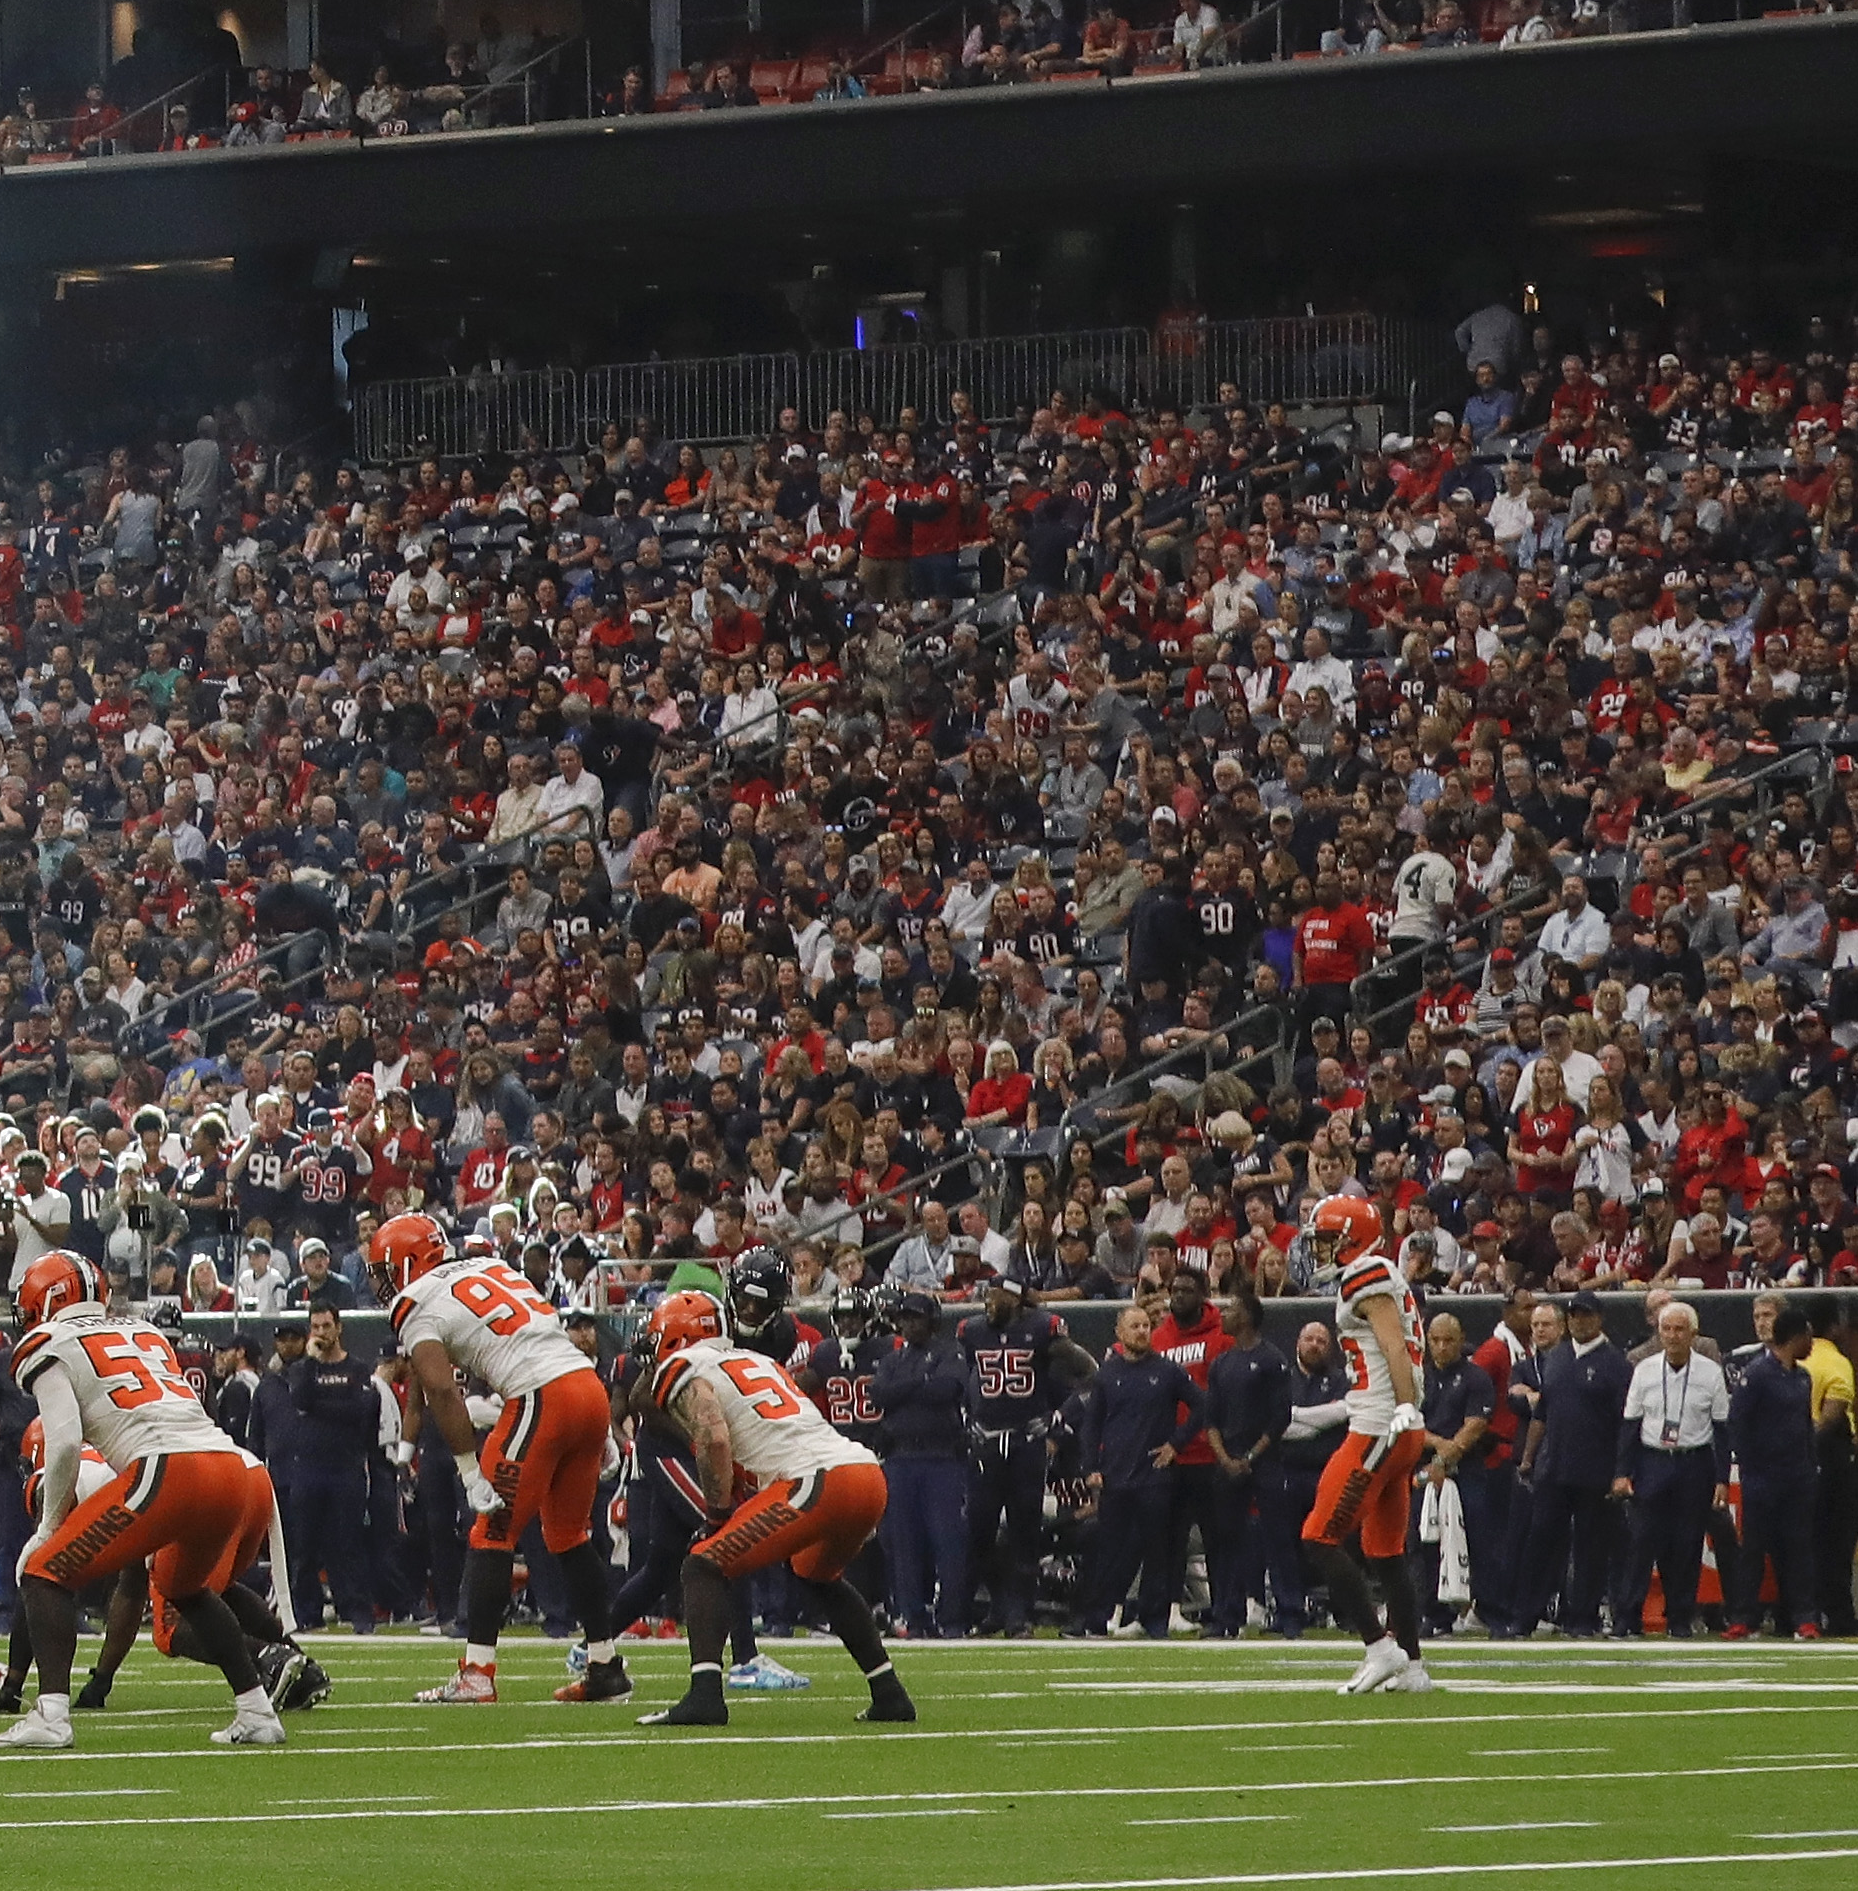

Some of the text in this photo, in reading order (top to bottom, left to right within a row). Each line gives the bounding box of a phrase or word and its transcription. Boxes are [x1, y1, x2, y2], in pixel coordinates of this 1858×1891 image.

[45, 536, 56, 555] 4
[1404, 862, 1424, 899] 4
[60, 900, 83, 924] 99
[1202, 902, 1233, 935] 90
[1031, 934, 1060, 958] 90
[248, 1153, 281, 1186] 99
[383, 1140, 397, 1164] 4
[300, 1163, 346, 1202] 99
[475, 1162, 494, 1187] 10
[452, 1265, 558, 1337] 95
[88, 1336, 196, 1411] 53
[976, 1349, 1035, 1397] 55
[1324, 1466, 1370, 1544] BROWNS
[48, 1505, 132, 1583] BROWNS
[700, 1502, 796, 1570] BROWNS
